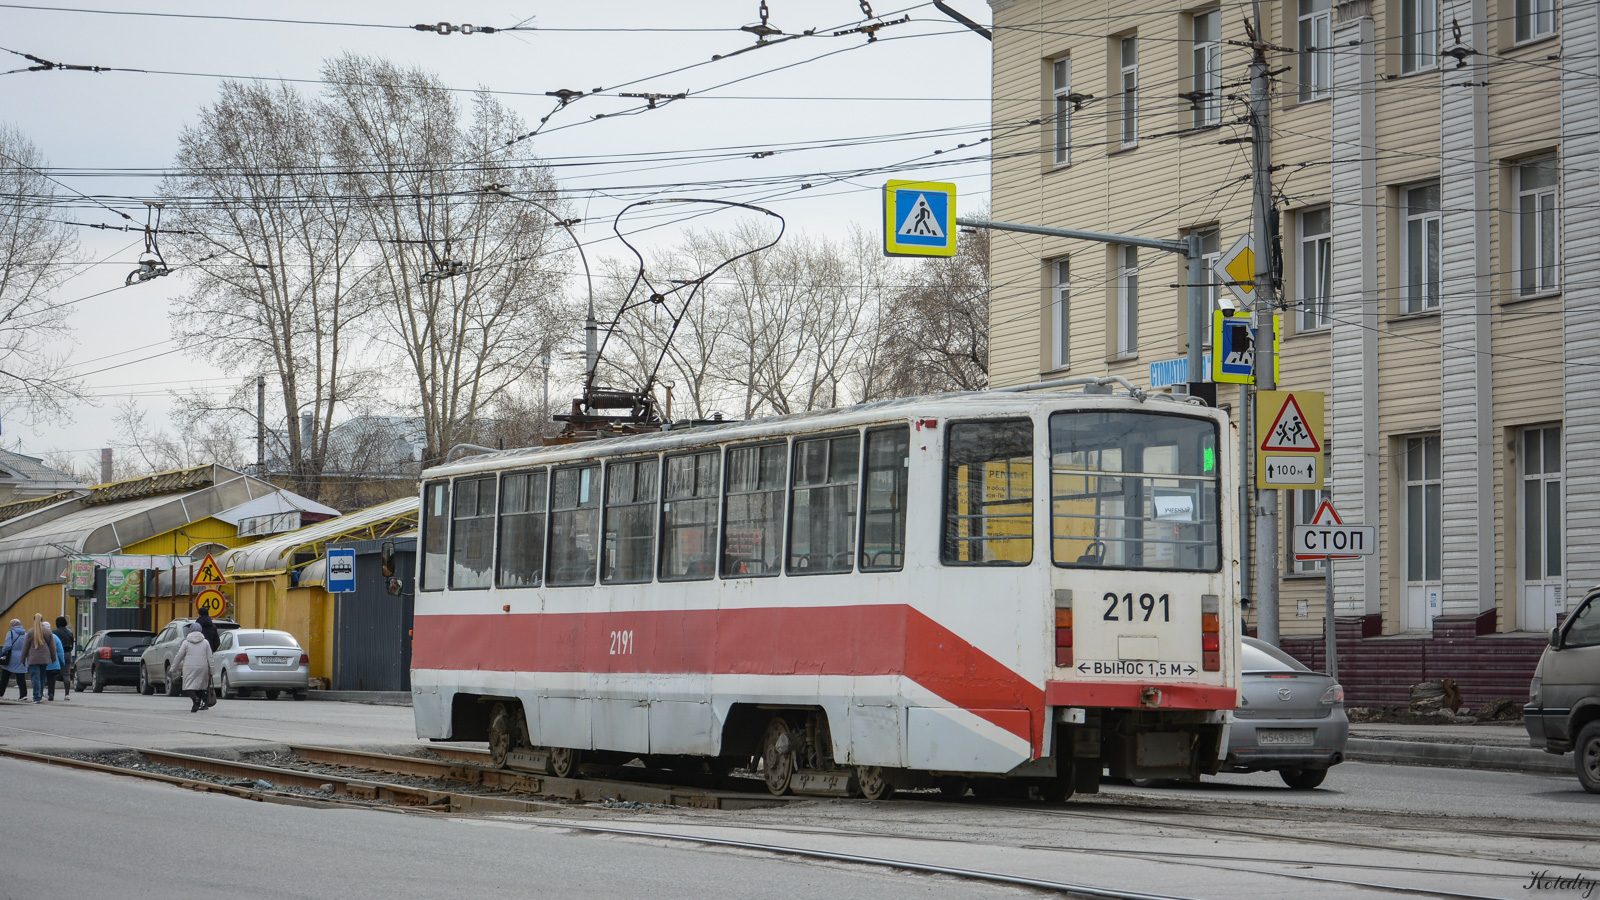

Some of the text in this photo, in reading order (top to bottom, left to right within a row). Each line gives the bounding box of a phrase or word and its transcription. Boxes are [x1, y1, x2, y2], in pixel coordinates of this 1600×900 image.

[1150, 355, 1207, 388] СТОМАТОЛЯ
[1164, 506, 1191, 514] УЧЕБНЫЙ
[1304, 530, 1363, 550] СТОП
[202, 598, 220, 610] 40
[1103, 592, 1170, 622] 2191
[609, 630, 633, 655] 2191
[1094, 662, 1181, 677] ВЫНОС 1,5 М
